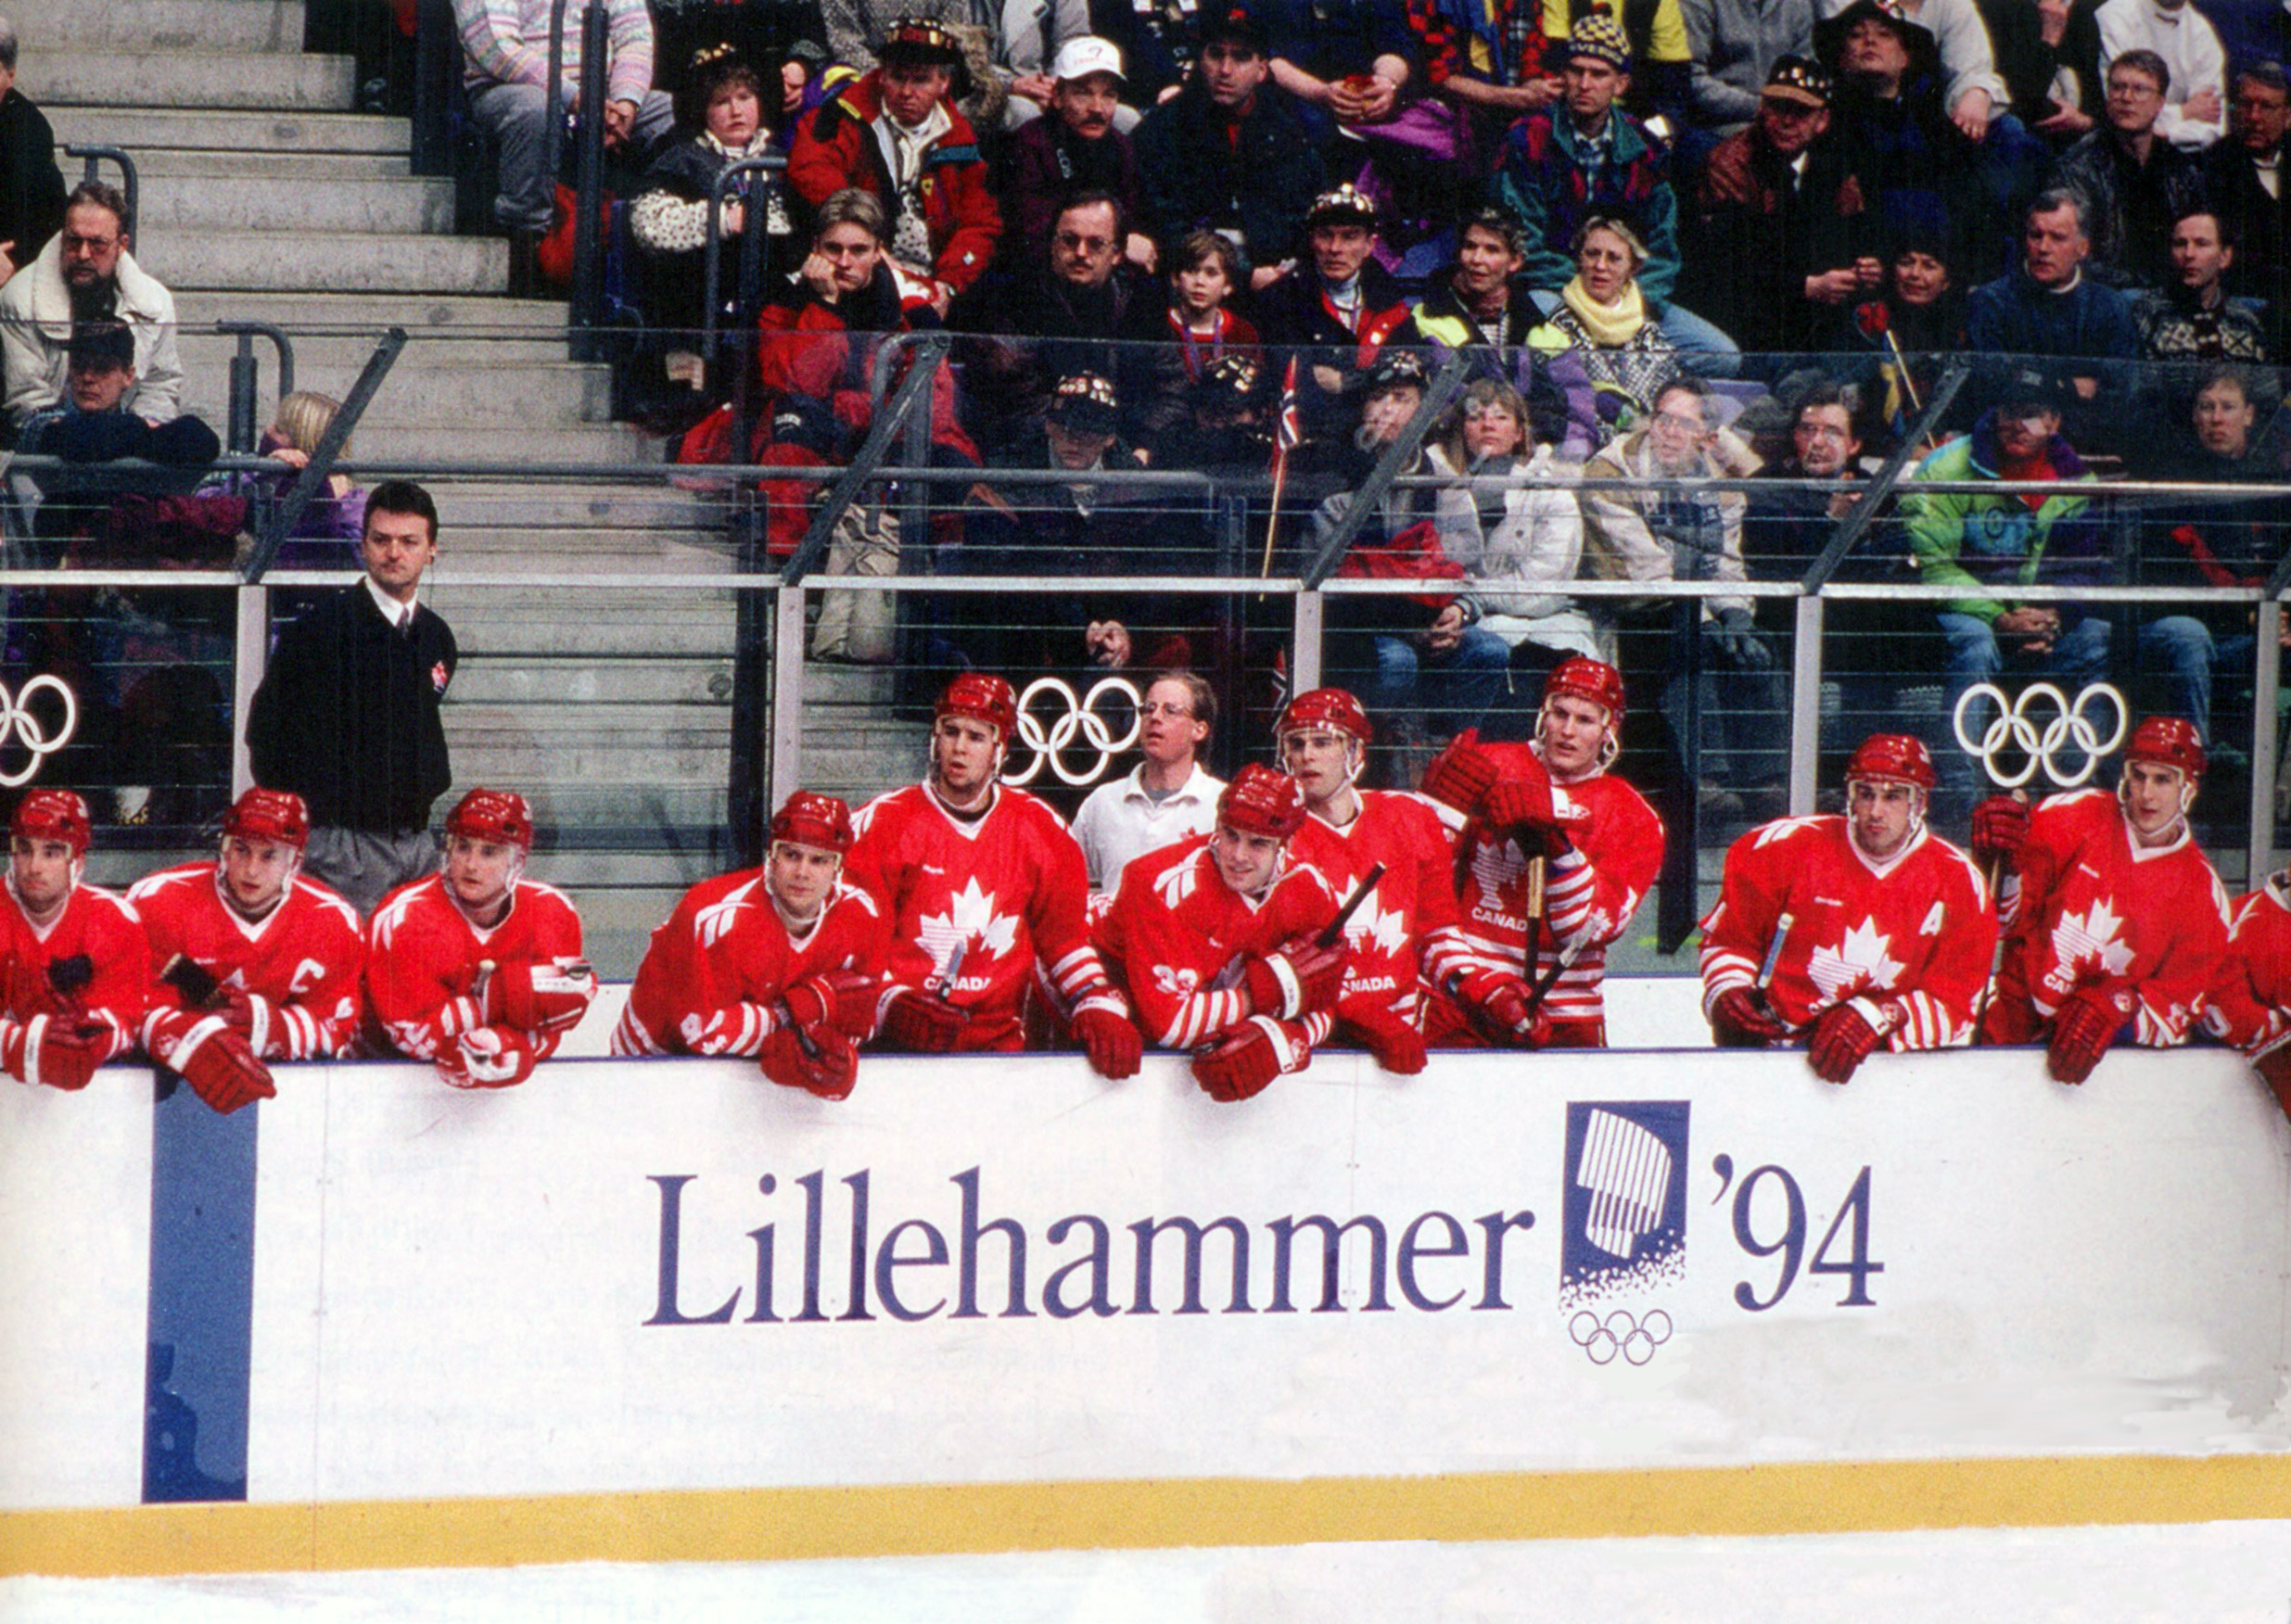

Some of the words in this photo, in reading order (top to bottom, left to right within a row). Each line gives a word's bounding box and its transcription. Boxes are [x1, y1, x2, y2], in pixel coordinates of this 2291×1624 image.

[1470, 907, 1529, 933] CANAD
[1918, 900, 1944, 936] A
[289, 958, 325, 993] C
[1341, 975, 1396, 993] NADA
[641, 1164, 1536, 1326] Lillehammer
